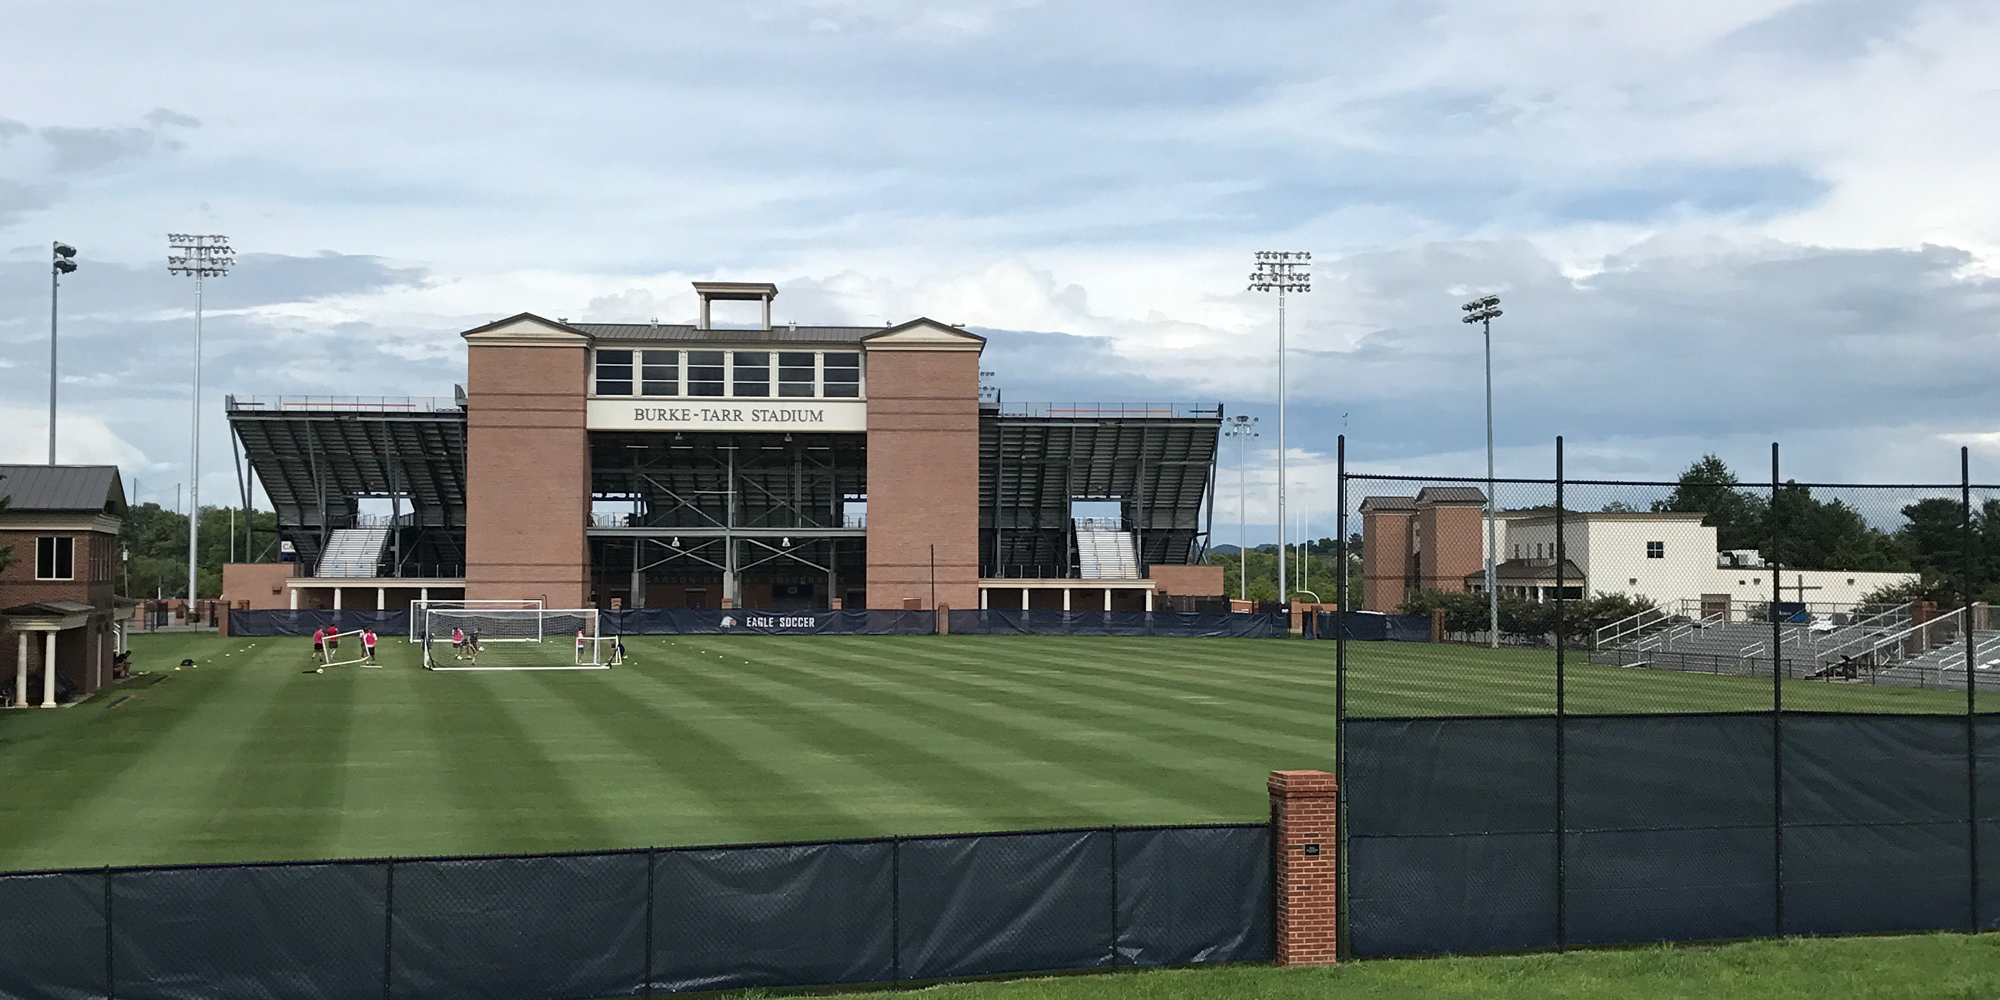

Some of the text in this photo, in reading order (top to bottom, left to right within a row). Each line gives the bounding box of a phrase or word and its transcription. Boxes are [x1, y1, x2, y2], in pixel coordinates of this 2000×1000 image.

[634, 408, 824, 423] BURKE-TARR STADIUM
[768, 576, 846, 584] UNIVERSIY
[746, 617, 815, 628] EAGLE SOCCER
